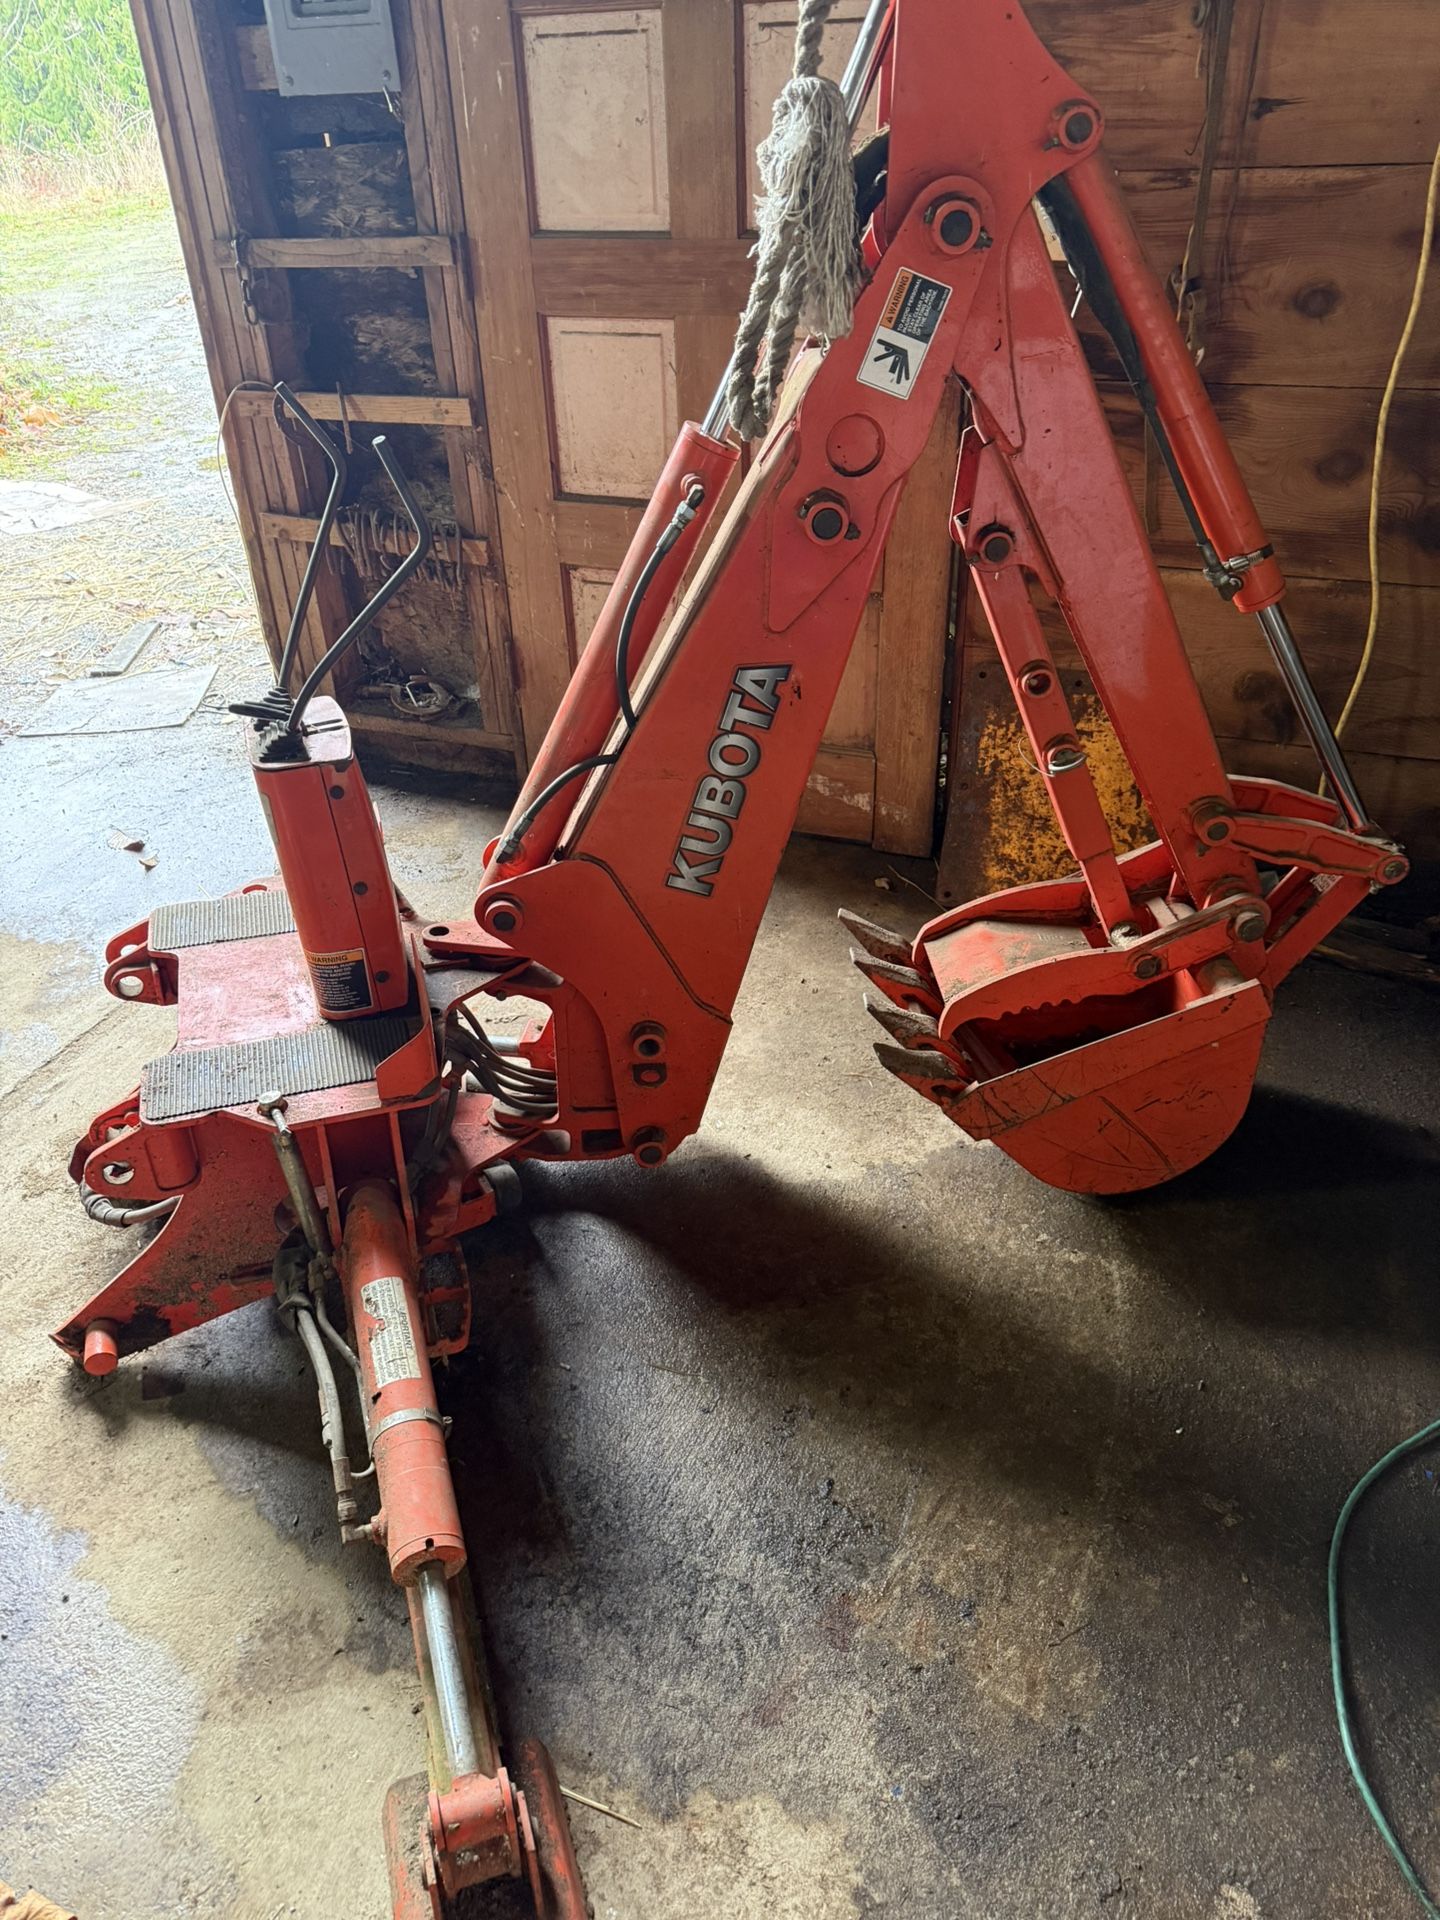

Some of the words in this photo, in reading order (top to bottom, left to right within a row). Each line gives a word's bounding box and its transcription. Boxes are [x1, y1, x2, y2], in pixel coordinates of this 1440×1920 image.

[888, 275, 909, 314] WARNING
[665, 664, 793, 897] KUBOTA
[311, 954, 348, 964] WARNING
